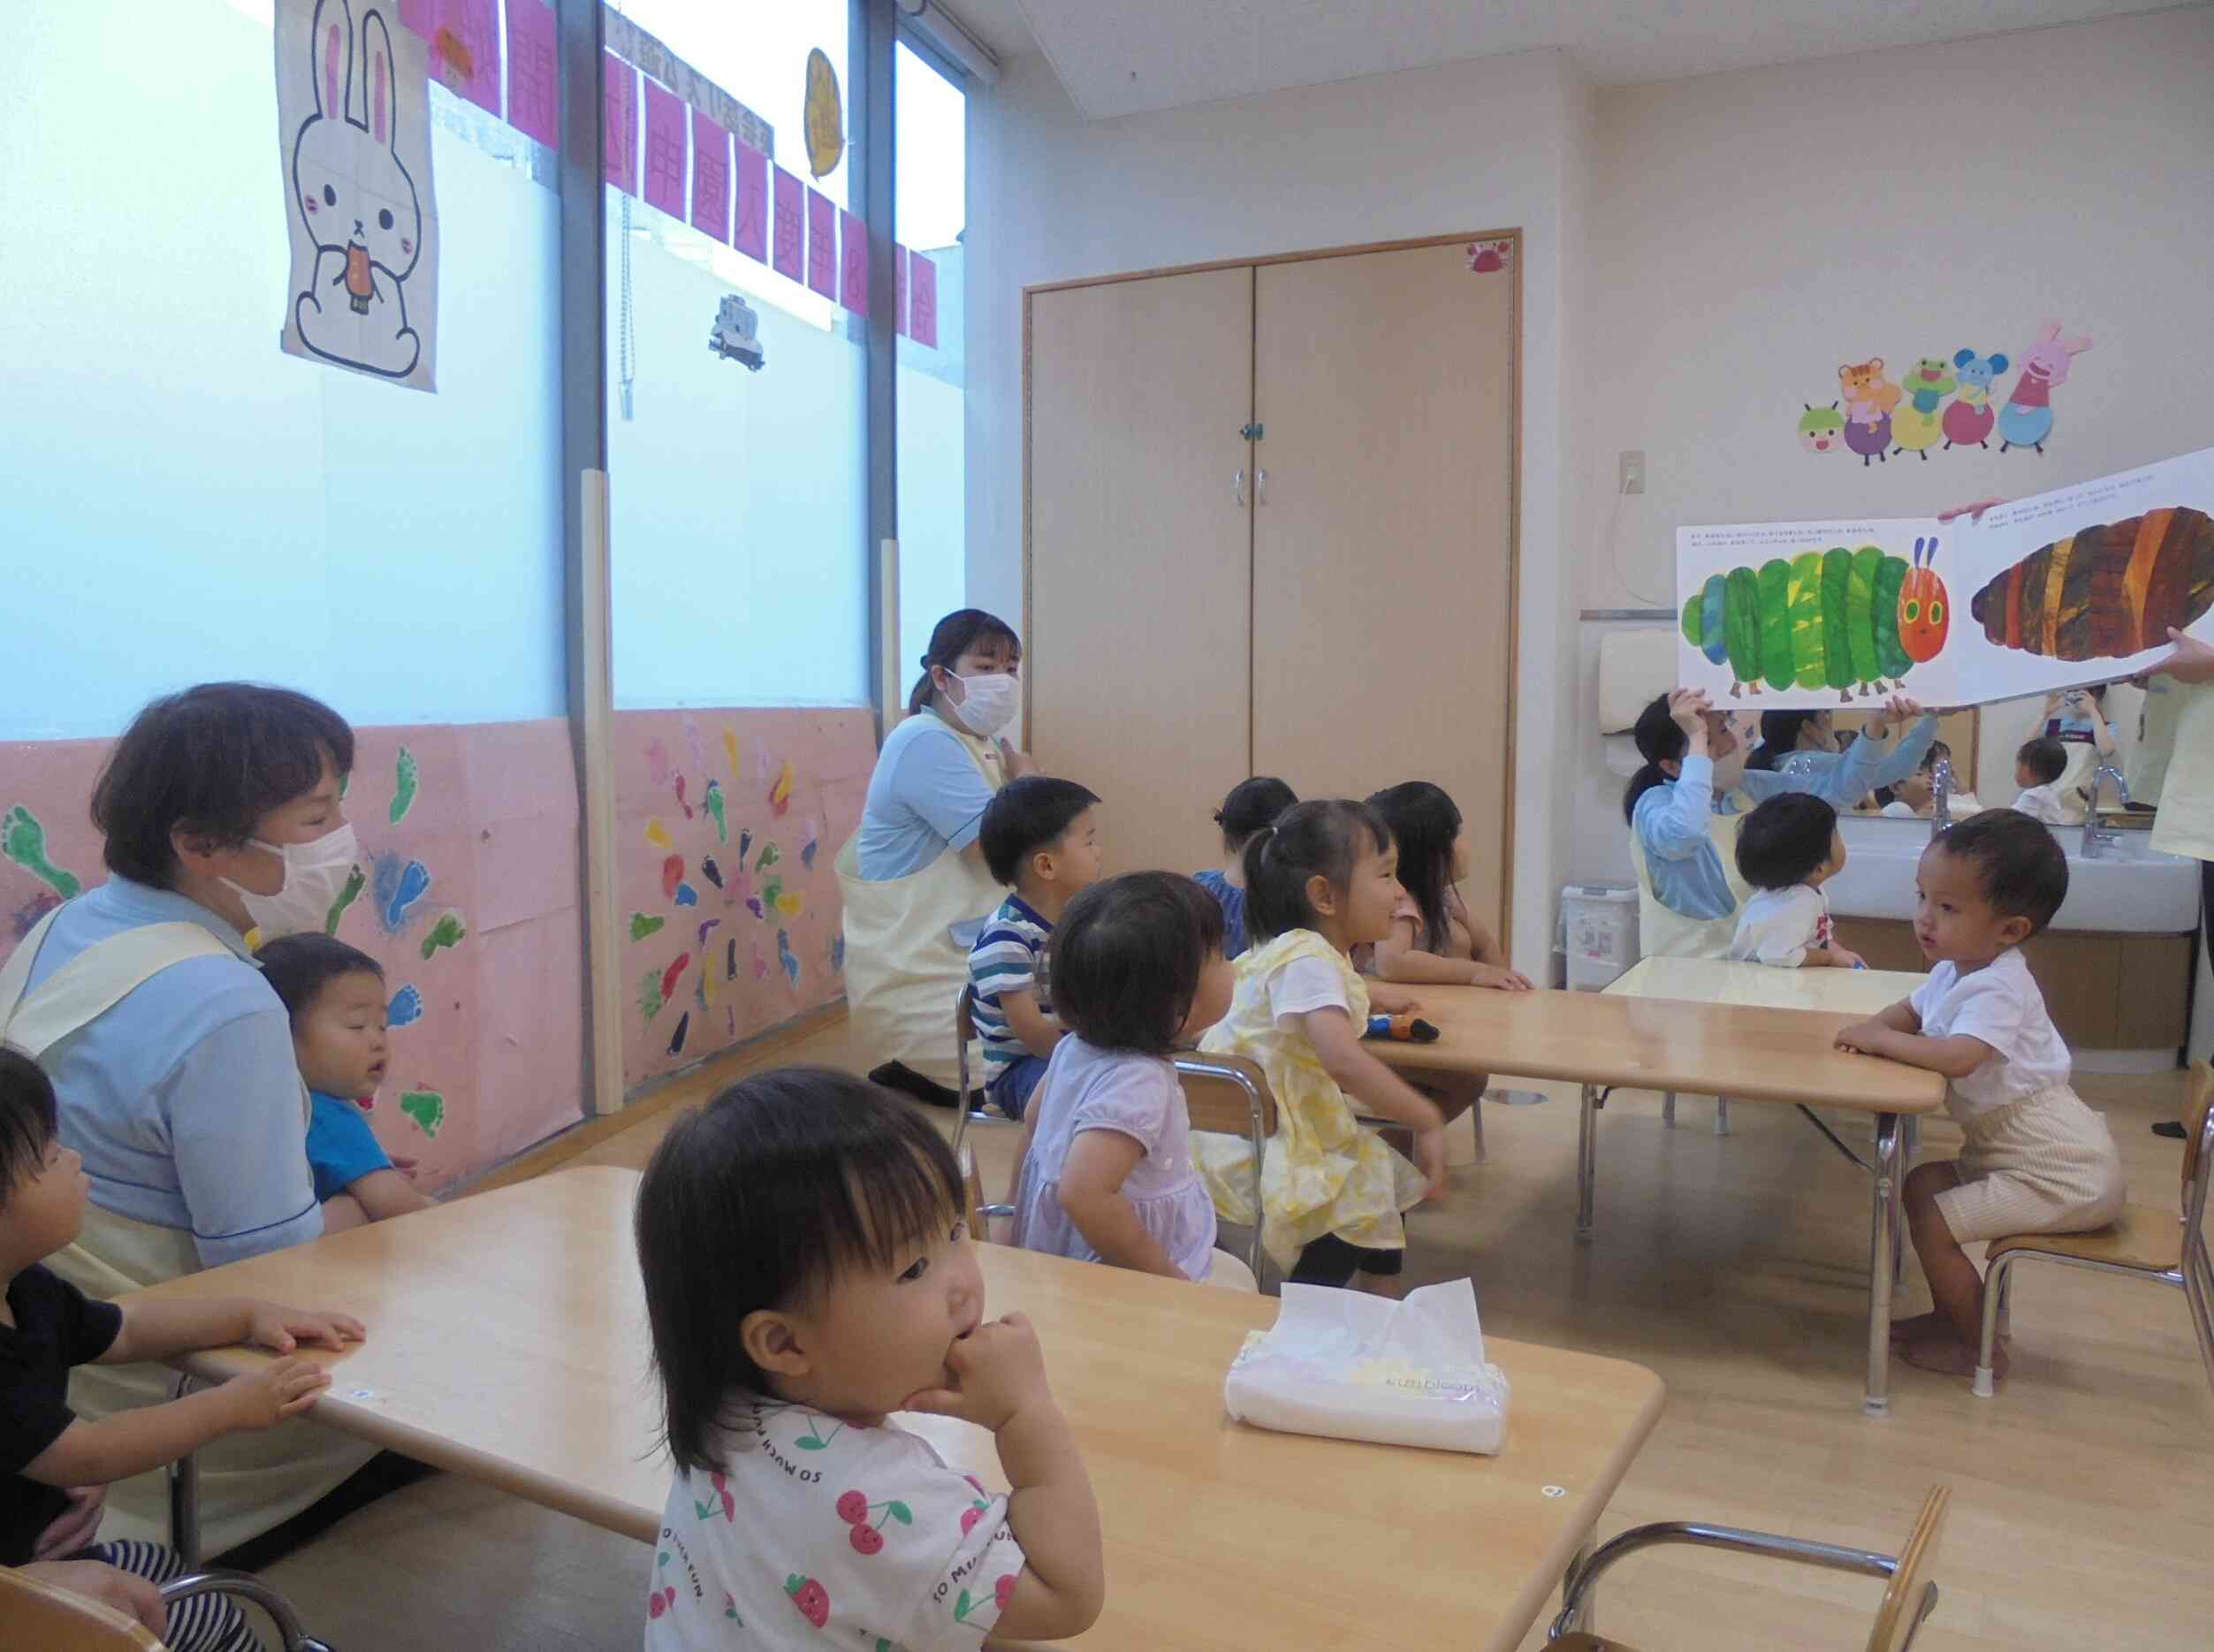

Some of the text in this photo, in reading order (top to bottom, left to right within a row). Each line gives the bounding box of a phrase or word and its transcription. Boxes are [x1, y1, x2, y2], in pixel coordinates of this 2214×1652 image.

[763, 1439, 796, 1475] MUCH
[799, 1469, 823, 1483] SO
[933, 1581, 948, 1604] SO
